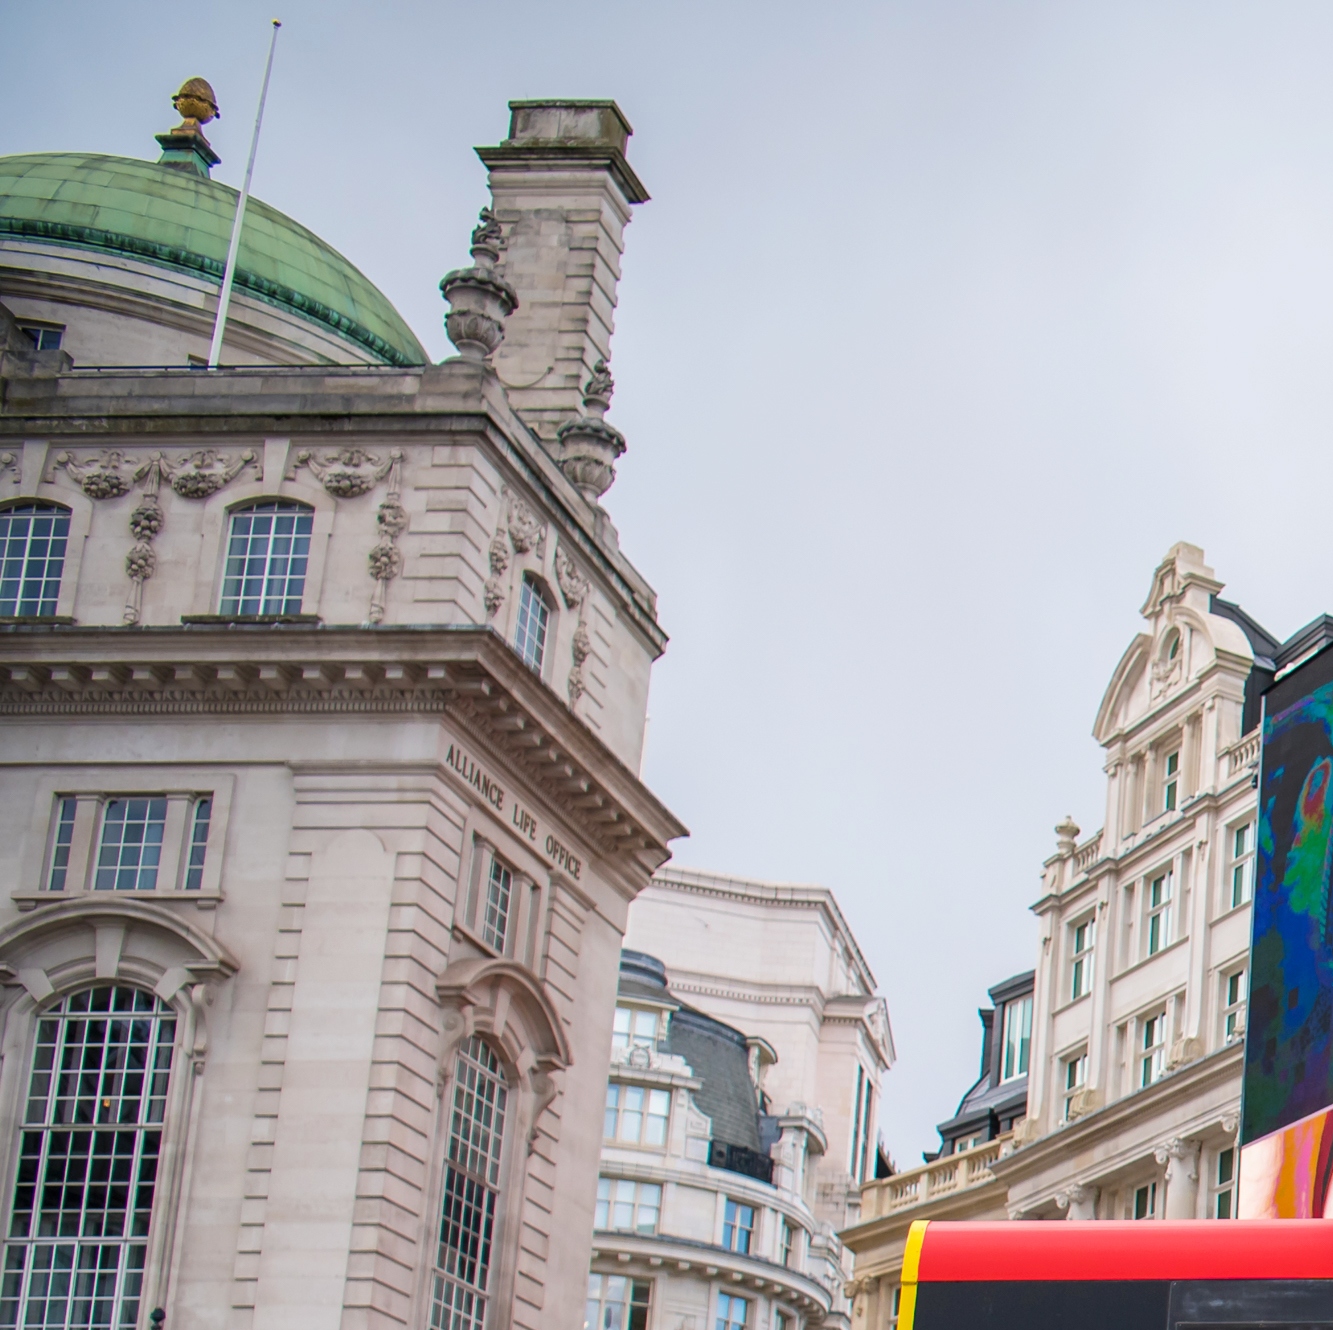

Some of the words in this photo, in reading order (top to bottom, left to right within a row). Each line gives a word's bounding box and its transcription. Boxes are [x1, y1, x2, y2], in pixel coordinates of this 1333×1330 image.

[446, 743, 504, 811] ALLIANCE
[512, 803, 537, 841] LIFE
[545, 834, 582, 880] OFFICE
